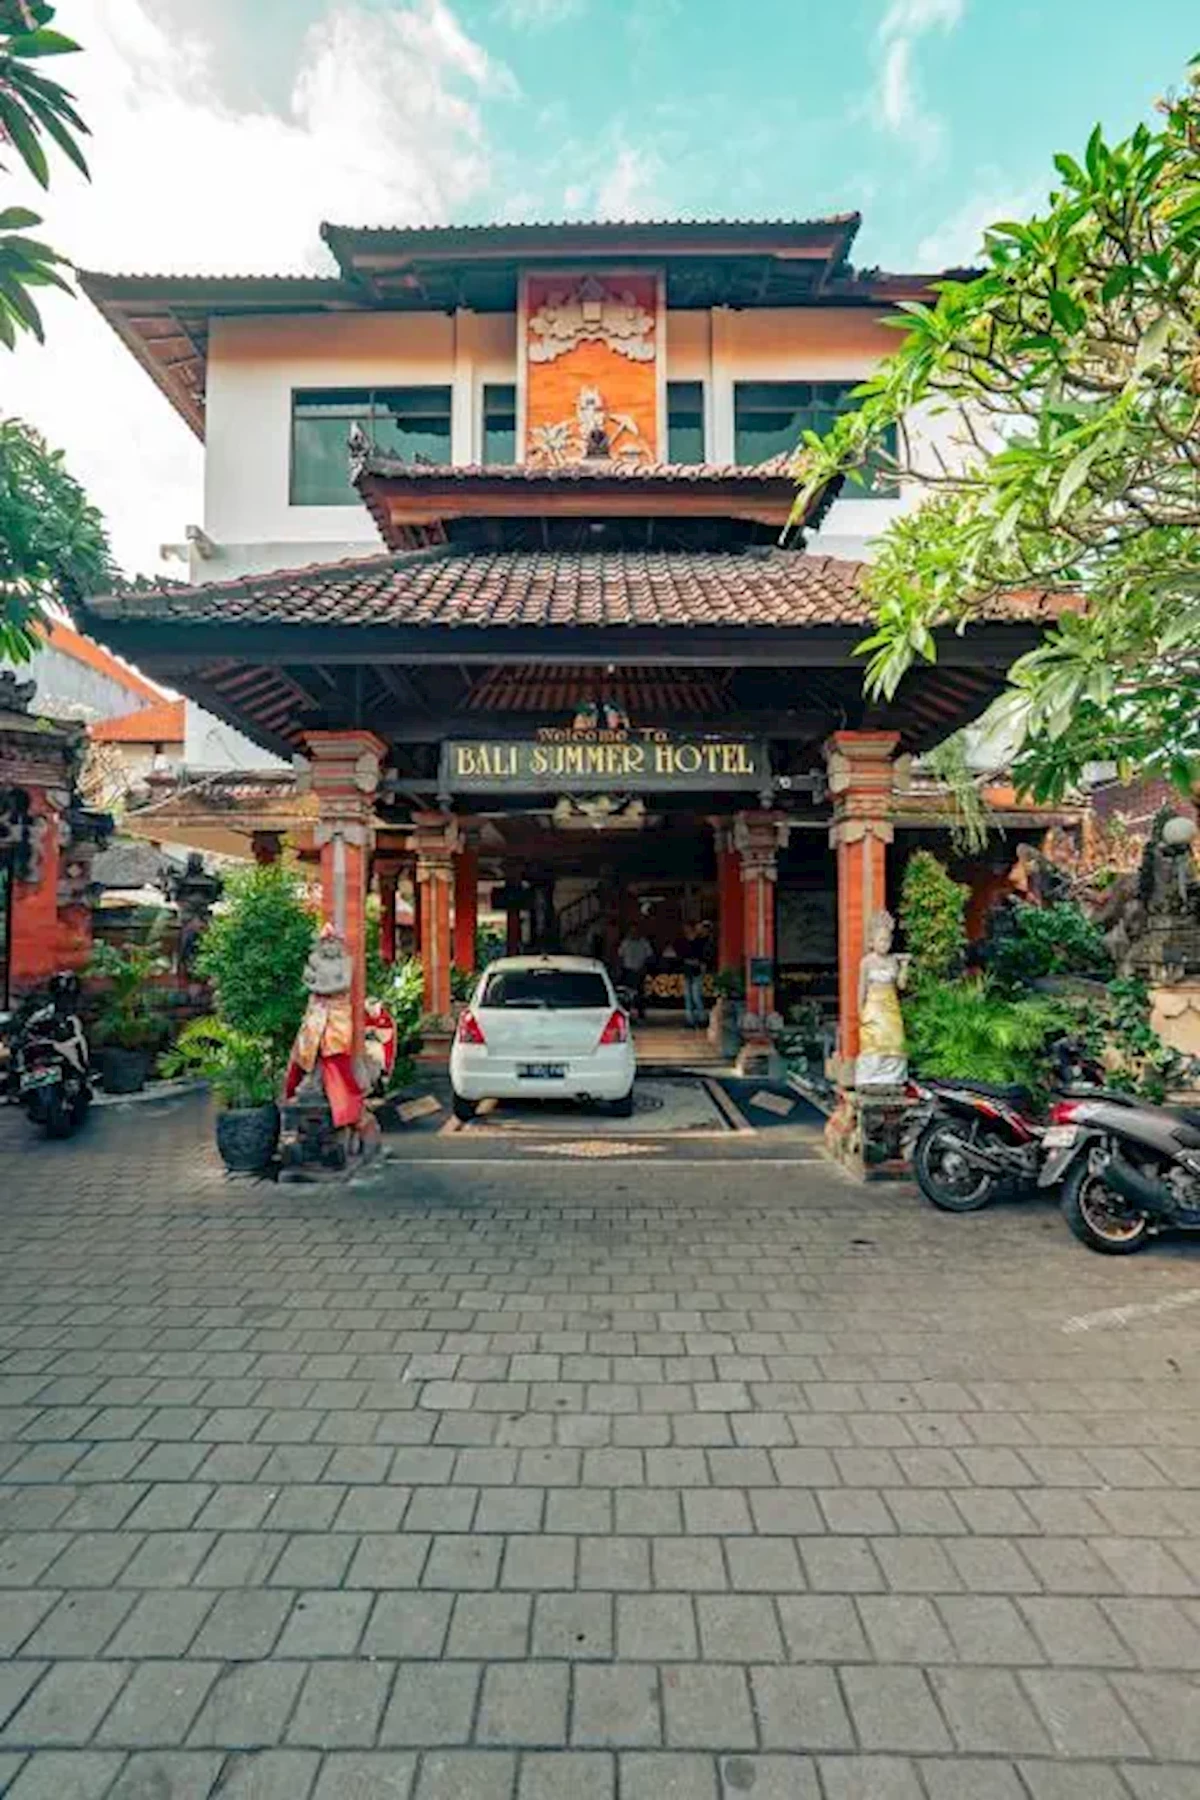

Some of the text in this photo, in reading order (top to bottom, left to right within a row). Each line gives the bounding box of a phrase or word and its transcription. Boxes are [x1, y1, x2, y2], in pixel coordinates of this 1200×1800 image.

[537, 727, 669, 742] Welcome To
[456, 744, 755, 775] BALI SUMMER HOTEL
